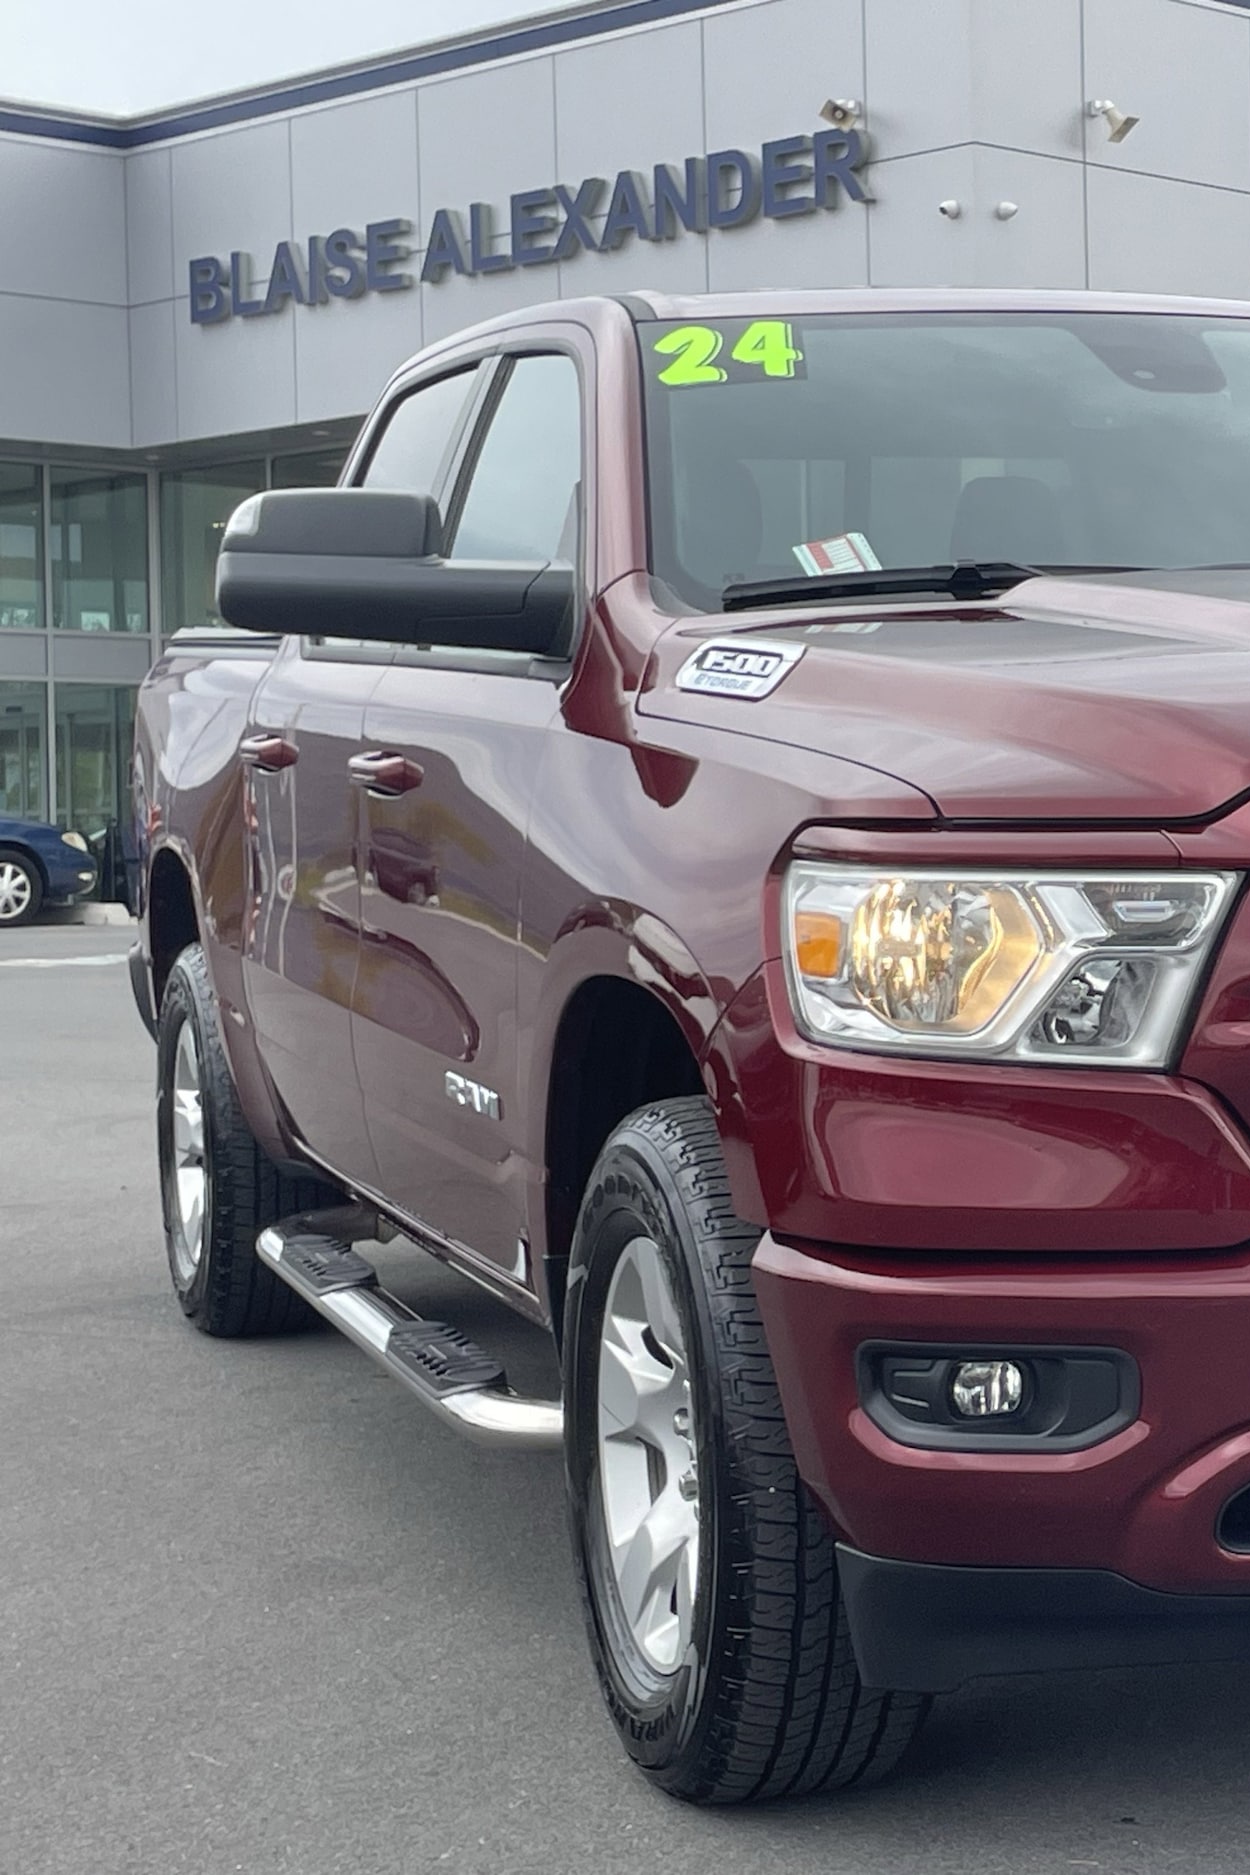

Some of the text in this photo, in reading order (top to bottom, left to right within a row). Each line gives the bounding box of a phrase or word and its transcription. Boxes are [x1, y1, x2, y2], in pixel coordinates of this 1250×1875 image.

[189, 129, 876, 324] BLAISE ALEXANDER
[653, 320, 804, 386] 24
[701, 648, 782, 677] 1500
